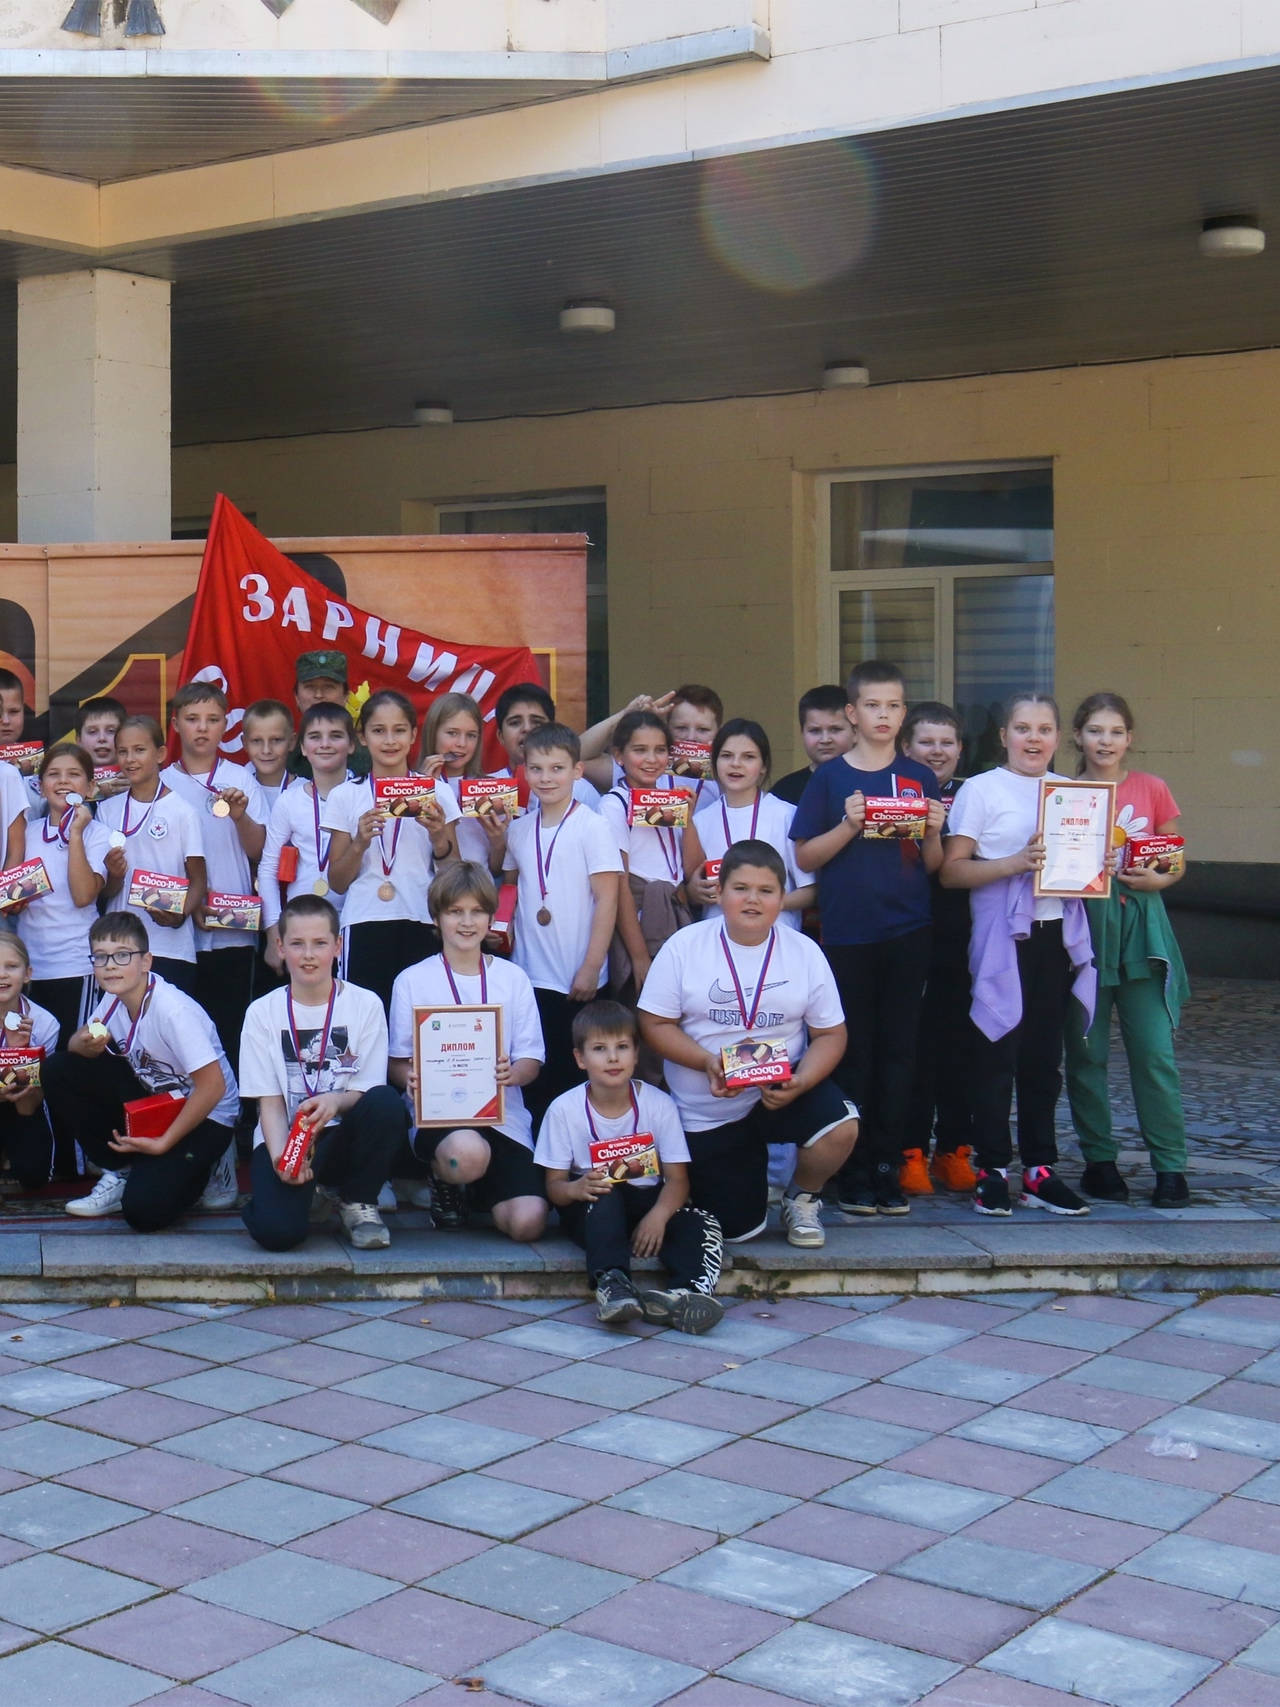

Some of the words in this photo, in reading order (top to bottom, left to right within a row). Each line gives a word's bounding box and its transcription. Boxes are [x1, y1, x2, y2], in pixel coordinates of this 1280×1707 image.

[240, 573, 495, 722] ЗАРНИЦ
[94, 770, 116, 779] co-Pie
[383, 785, 428, 795] Choco-Pie
[468, 784, 510, 794] Choco-Pie
[640, 794, 685, 804] Choco-Pie
[872, 812, 918, 821] Choco-Pie
[1140, 844, 1178, 855] Choco-Pie
[139, 875, 180, 888] Choco-Pie
[213, 897, 255, 907] Choco-Pie
[709, 1009, 741, 1025] JUST
[441, 1042, 475, 1052] ДИПЛОМ
[598, 1146, 647, 1159] Choco-Pie
